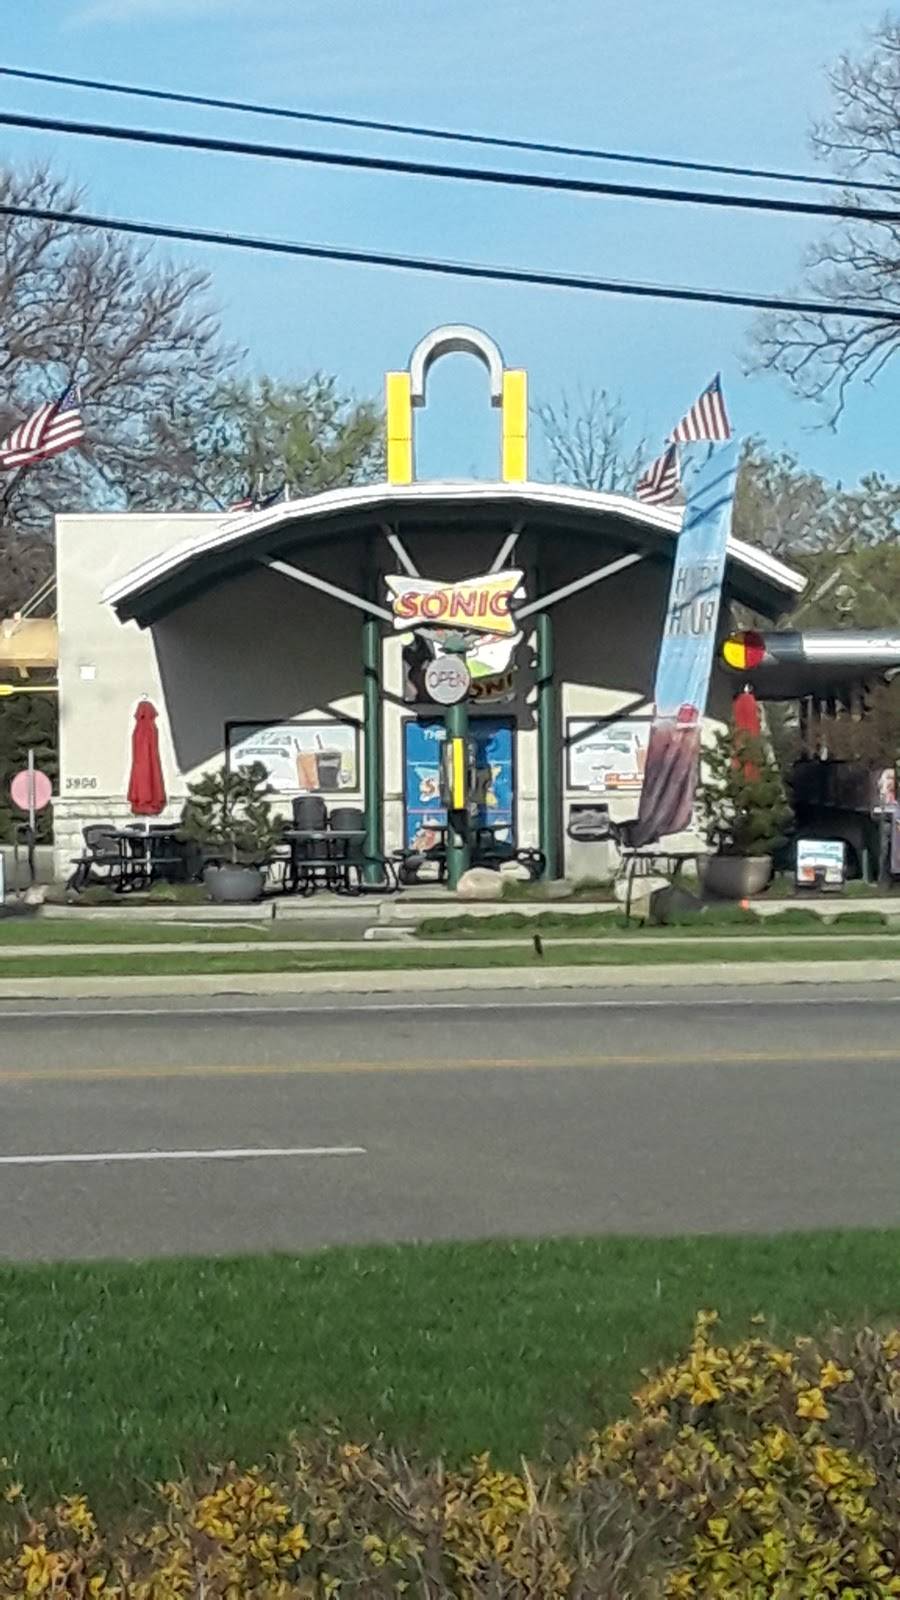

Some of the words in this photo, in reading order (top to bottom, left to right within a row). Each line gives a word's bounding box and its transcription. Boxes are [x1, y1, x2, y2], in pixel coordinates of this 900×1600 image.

[396, 590, 512, 619] SONIC
[669, 601, 715, 636] HUR
[429, 670, 467, 689] OPEN
